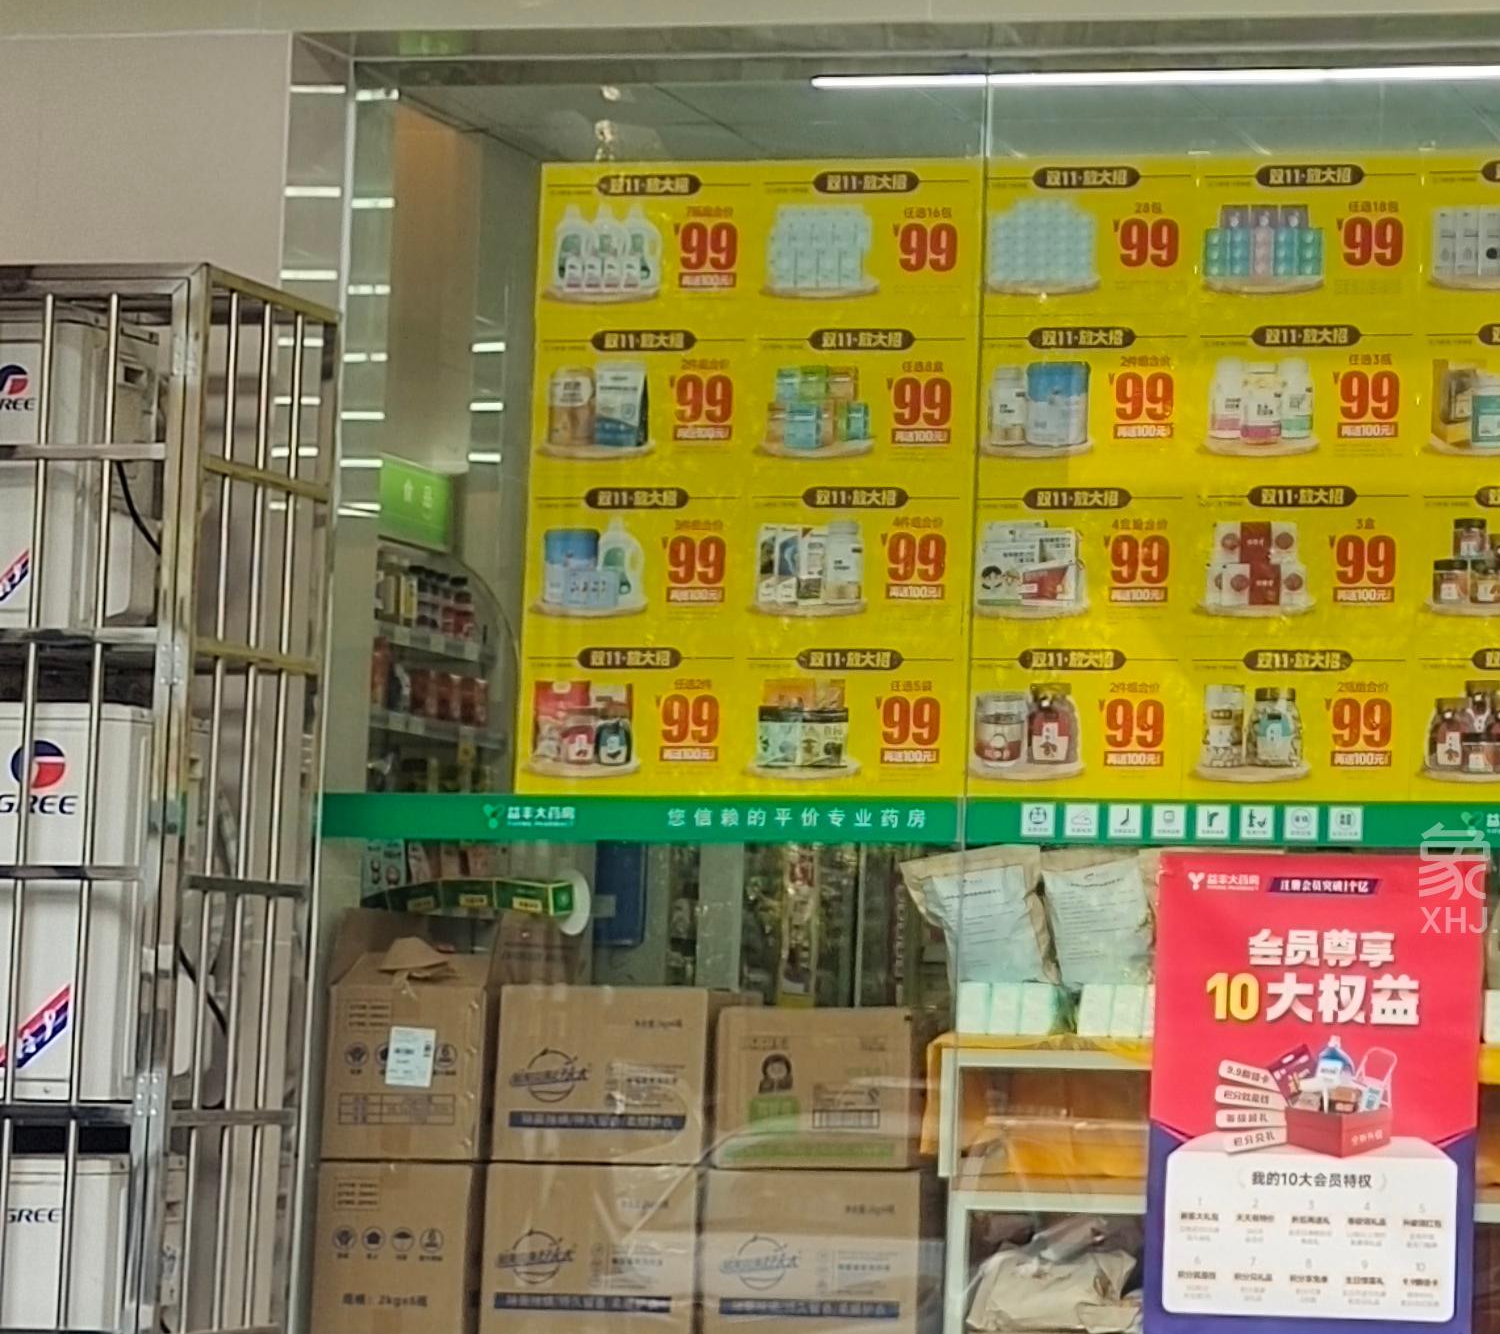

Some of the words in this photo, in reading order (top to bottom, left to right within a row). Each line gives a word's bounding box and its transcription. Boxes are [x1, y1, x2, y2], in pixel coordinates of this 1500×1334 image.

[0, 398, 36, 410] REE
[0, 794, 78, 815] GREE
[668, 808, 926, 828] 您信赖的平价专业药房
[1249, 929, 1395, 966] 会员尊享
[1206, 972, 1420, 1025] 10大权益
[1252, 1171, 1372, 1189] 我的10大会员特权
[7, 1208, 61, 1223] GREE
